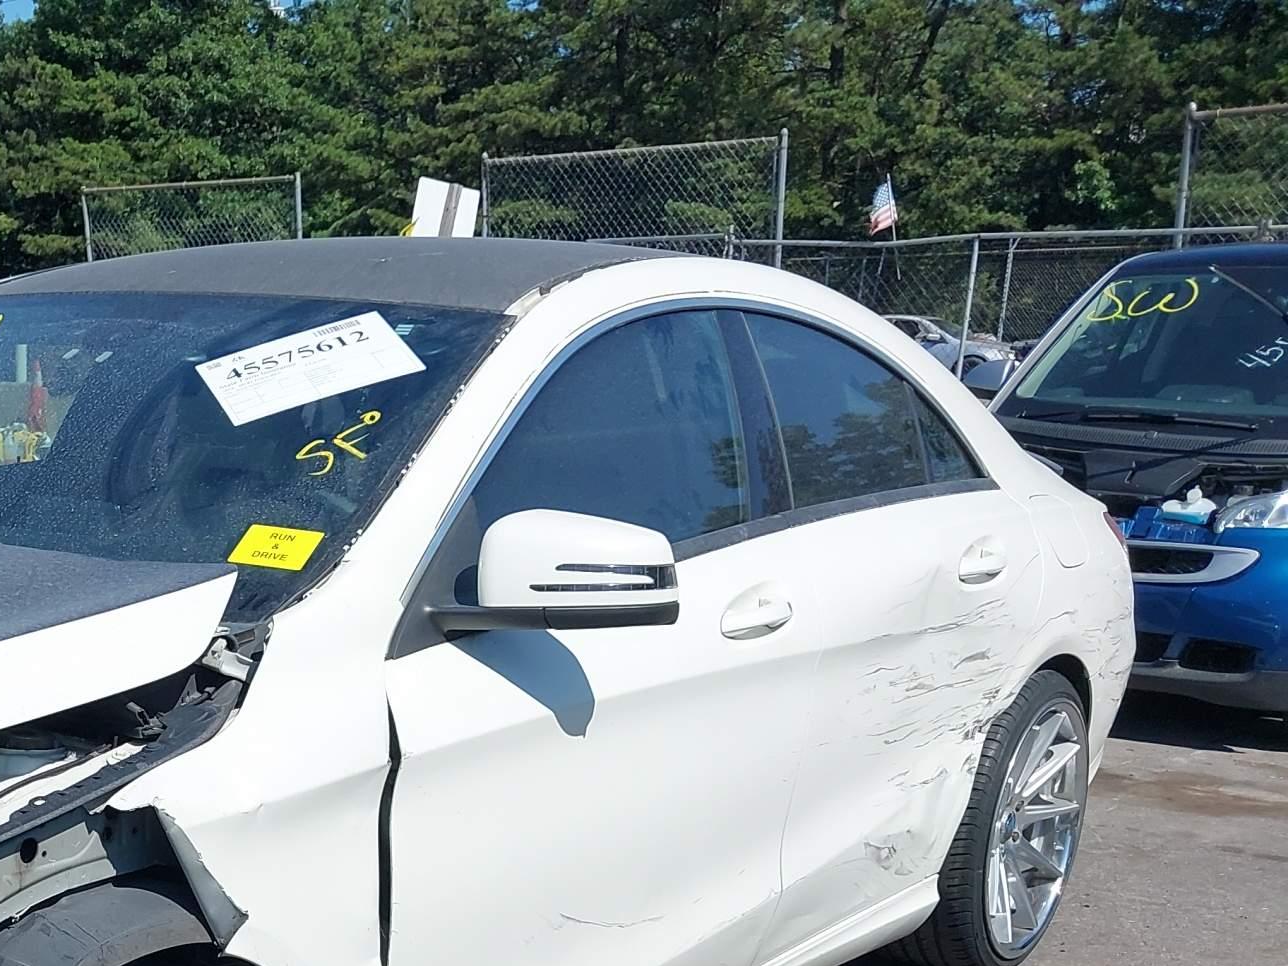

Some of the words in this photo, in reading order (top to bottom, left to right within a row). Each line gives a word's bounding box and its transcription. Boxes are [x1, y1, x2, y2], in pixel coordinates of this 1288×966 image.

[226, 329, 369, 381] 45575612
[269, 532, 297, 542] RUN
[251, 550, 289, 562] DRIVE
